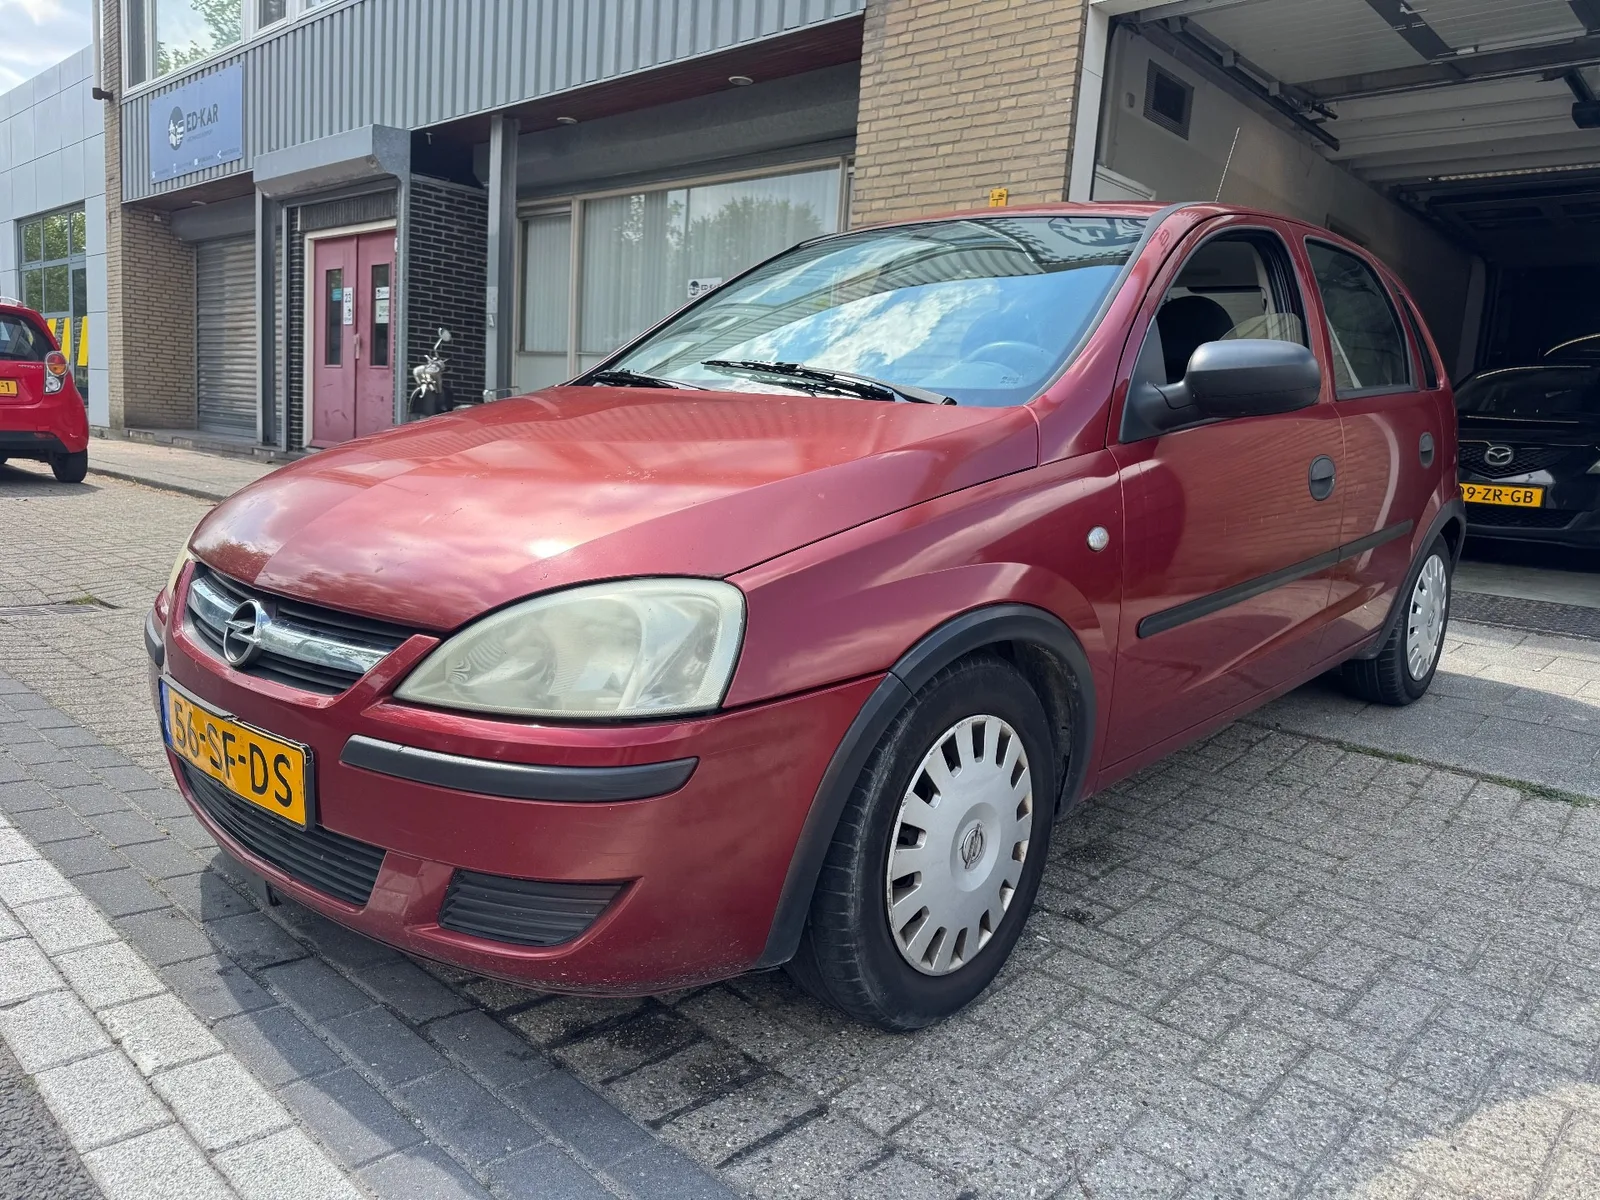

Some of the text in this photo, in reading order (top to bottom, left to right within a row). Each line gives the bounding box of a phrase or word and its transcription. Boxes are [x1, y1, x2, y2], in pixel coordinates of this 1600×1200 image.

[187, 103, 219, 132] ED-KAR
[345, 293, 351, 303] 23
[174, 700, 292, 808] 56-SF-DS
